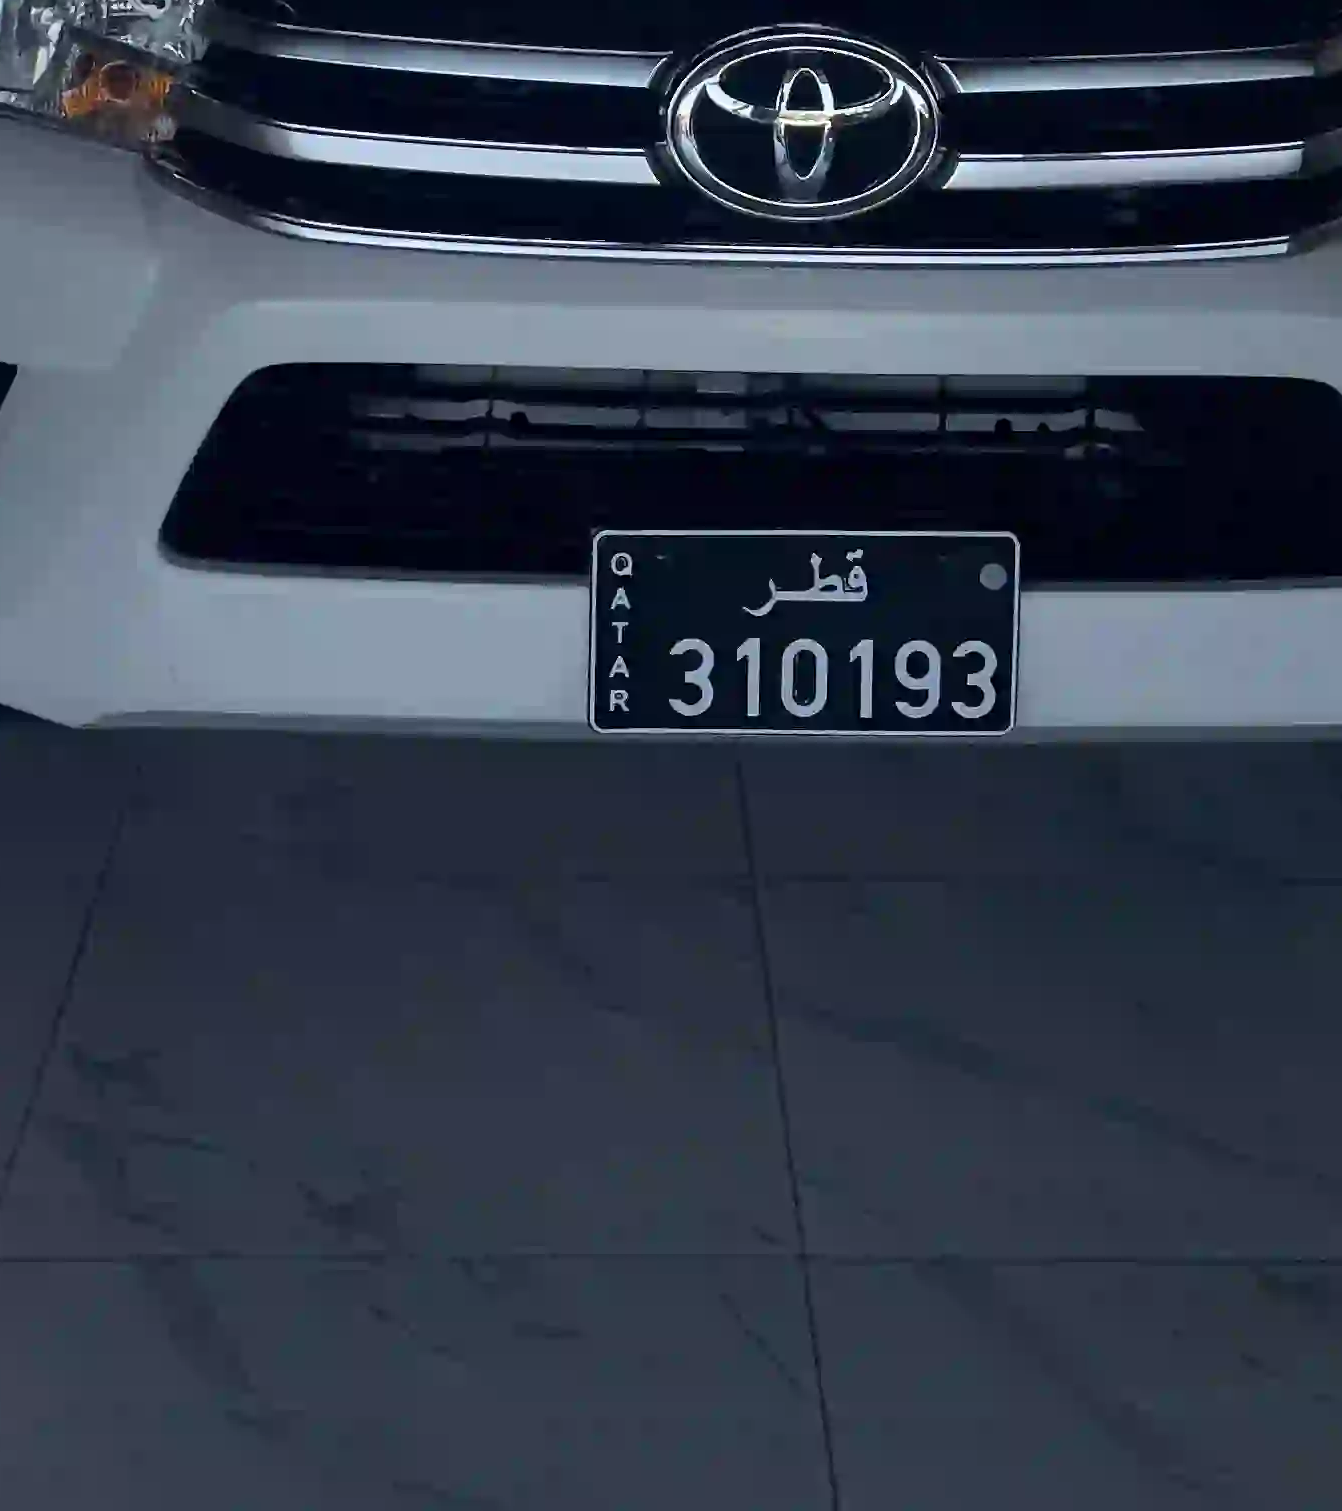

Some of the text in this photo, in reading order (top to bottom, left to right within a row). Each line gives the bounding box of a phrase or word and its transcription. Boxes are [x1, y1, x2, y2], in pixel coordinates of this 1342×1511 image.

[743, 548, 868, 616] قطر
[609, 552, 633, 712] QATAR
[668, 637, 998, 719] 310193
